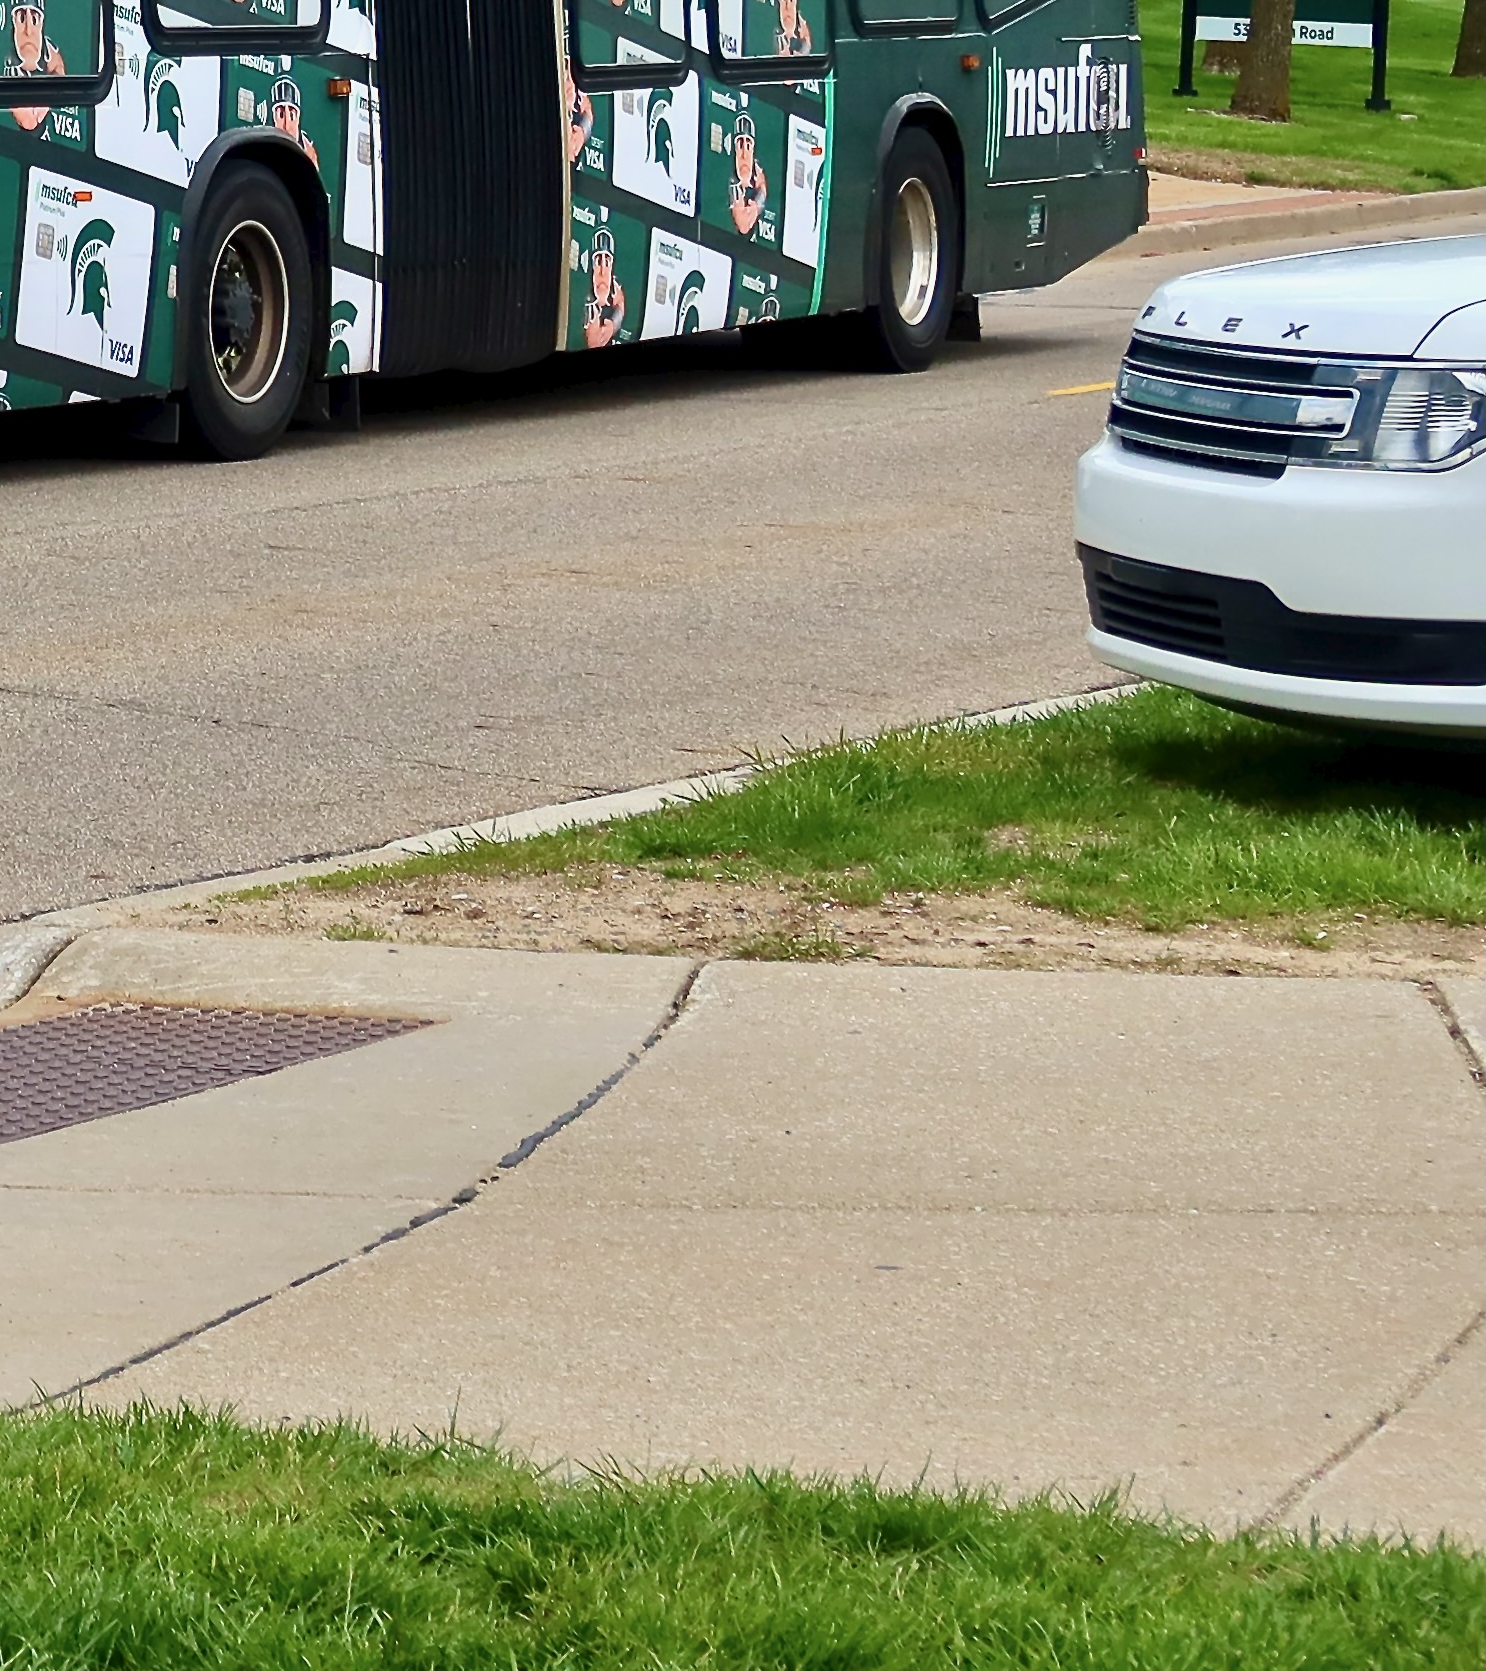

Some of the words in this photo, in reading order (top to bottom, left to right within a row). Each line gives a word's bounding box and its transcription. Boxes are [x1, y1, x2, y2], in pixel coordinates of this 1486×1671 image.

[1299, 25, 1334, 41] Road
[51, 112, 81, 142] VISA
[1141, 305, 1309, 340] FLEX
[108, 338, 134, 366] VISA
